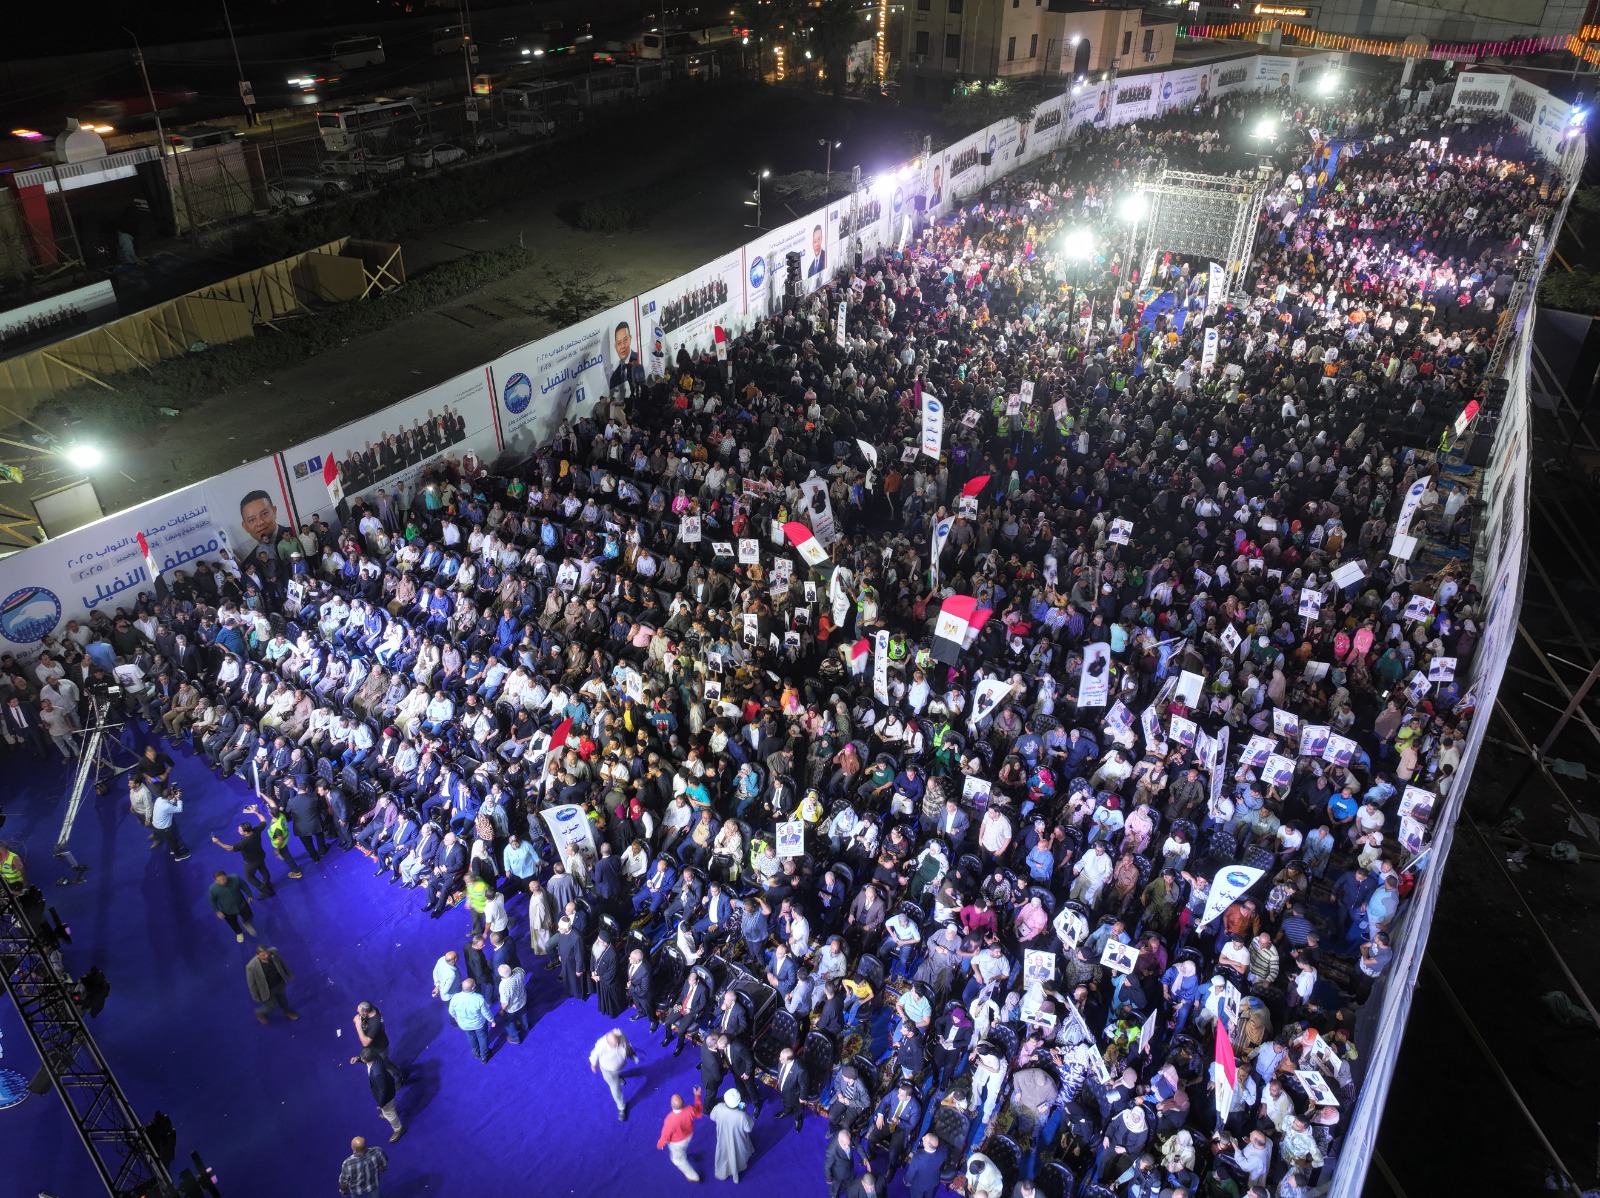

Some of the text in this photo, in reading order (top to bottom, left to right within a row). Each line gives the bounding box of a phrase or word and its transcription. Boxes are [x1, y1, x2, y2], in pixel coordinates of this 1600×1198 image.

[540, 354, 603, 395] مصطفى النفيلى
[167, 505, 208, 527] انتخابات
[96, 537, 130, 558] النواب
[67, 552, 94, 569] ٢٠٢٥
[78, 564, 103, 580] ٢٠٢٥
[82, 565, 147, 609] النفيلى
